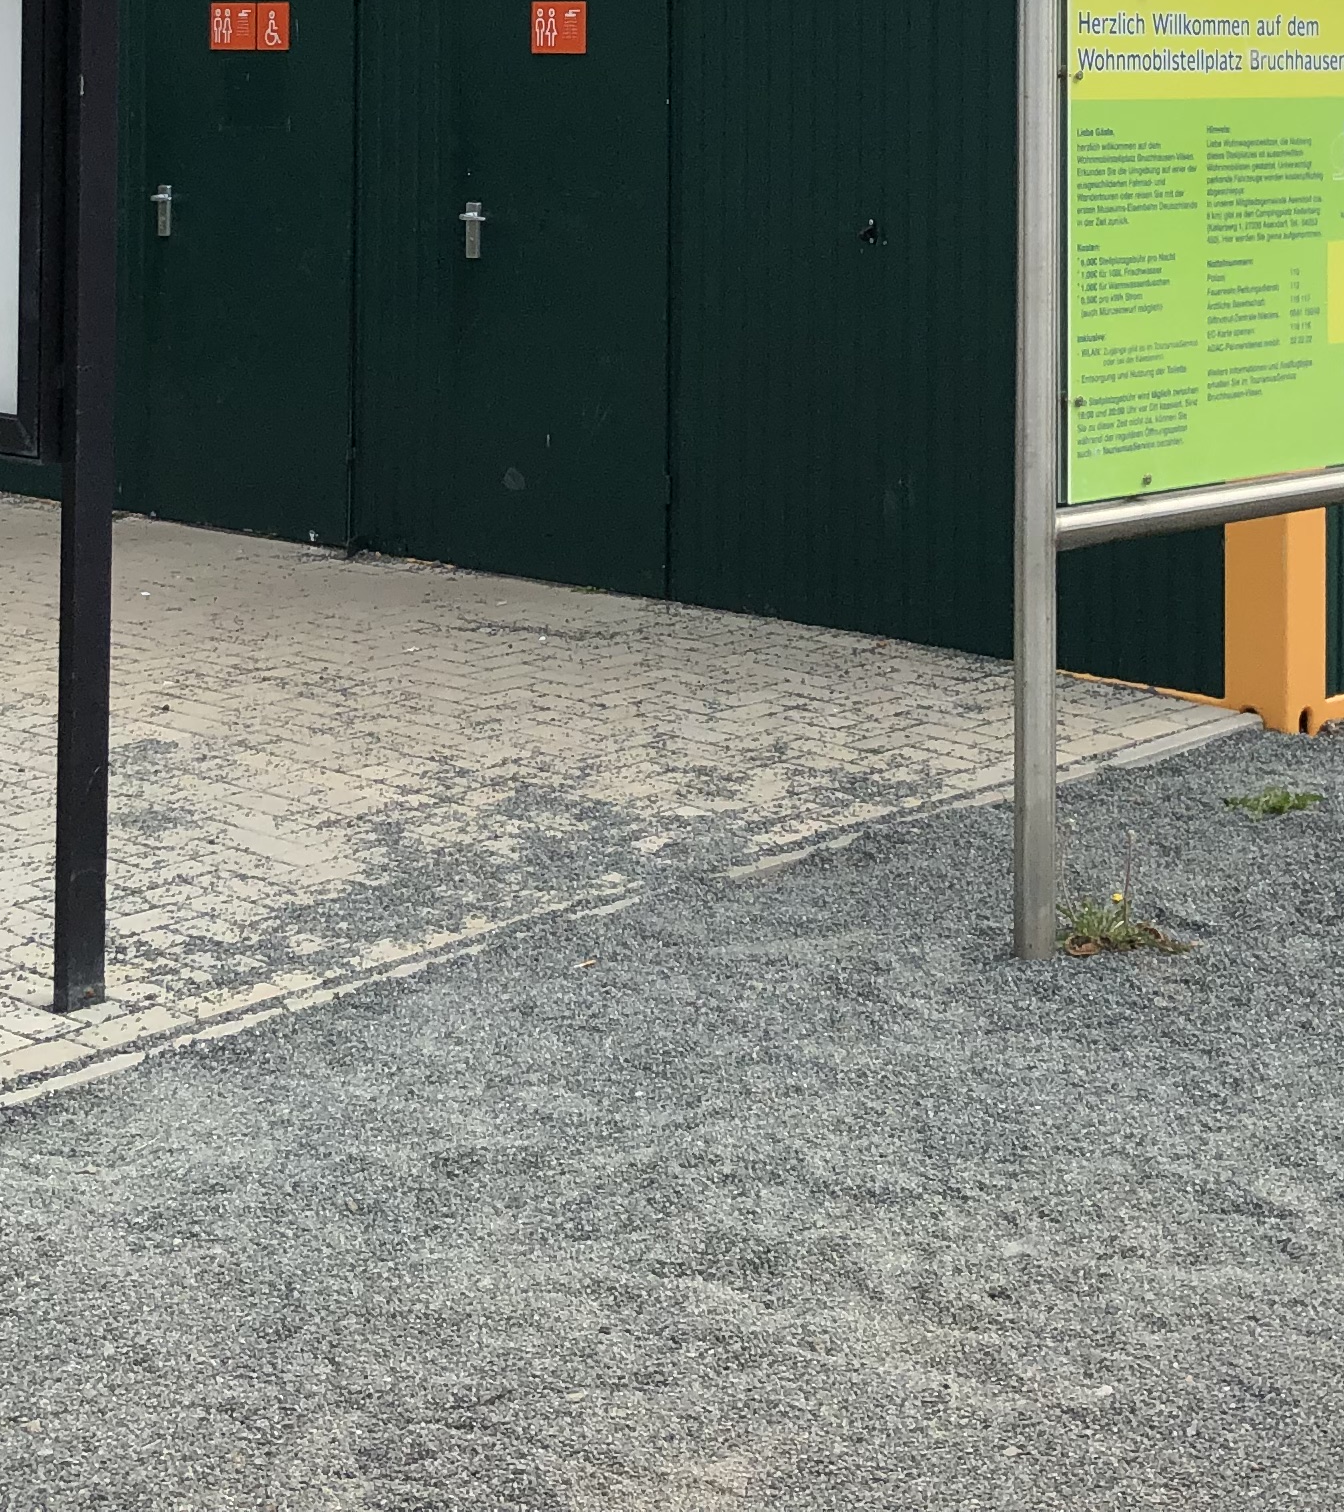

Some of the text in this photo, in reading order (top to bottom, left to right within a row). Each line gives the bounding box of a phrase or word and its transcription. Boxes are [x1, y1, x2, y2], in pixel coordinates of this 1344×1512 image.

[1077, 11, 1319, 37] Herzlich Willkommen auf dem
[1078, 47, 1242, 74] Wohnmobilstellplatz
[1077, 128, 1094, 137] Liebe
